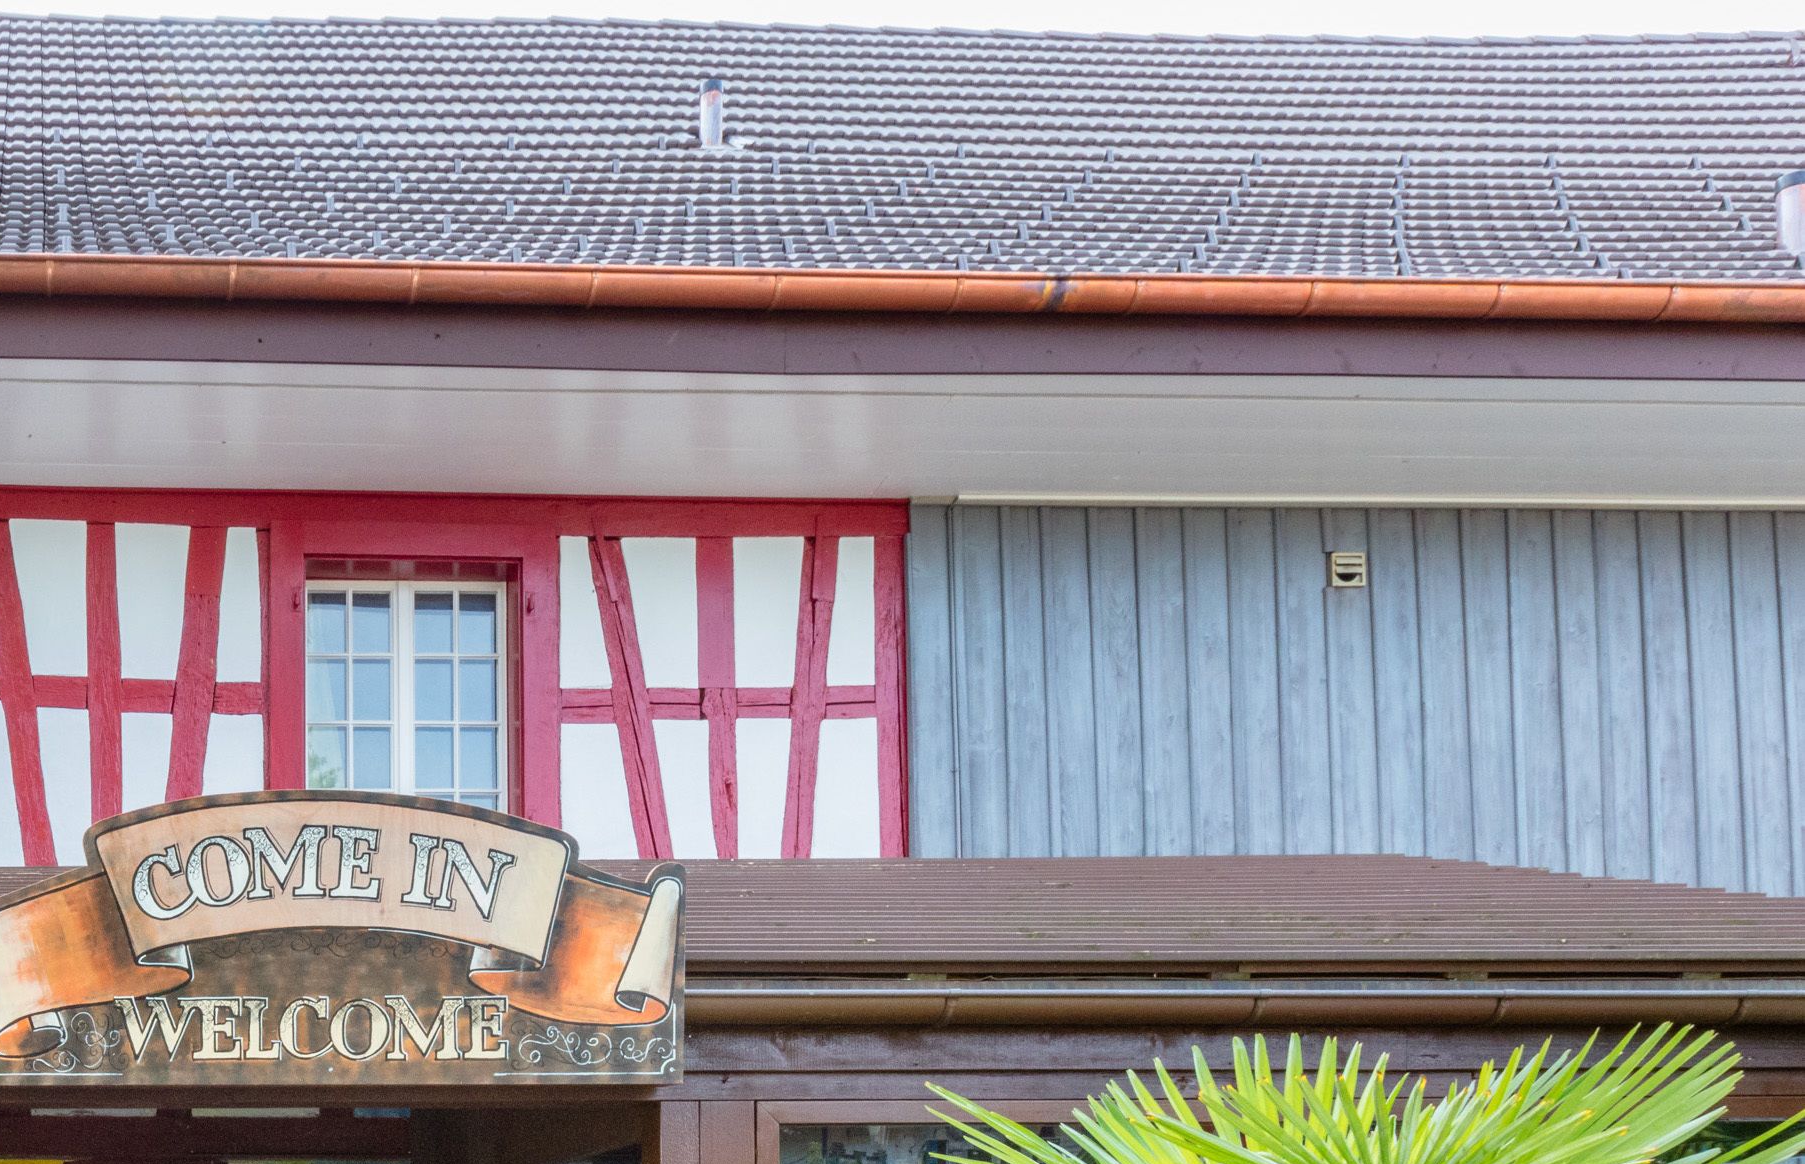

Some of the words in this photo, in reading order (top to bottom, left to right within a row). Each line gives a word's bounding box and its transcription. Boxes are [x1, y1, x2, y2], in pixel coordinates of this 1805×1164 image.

[132, 824, 382, 921] COME
[400, 833, 515, 924] IN
[114, 994, 511, 1062] WELCOME
